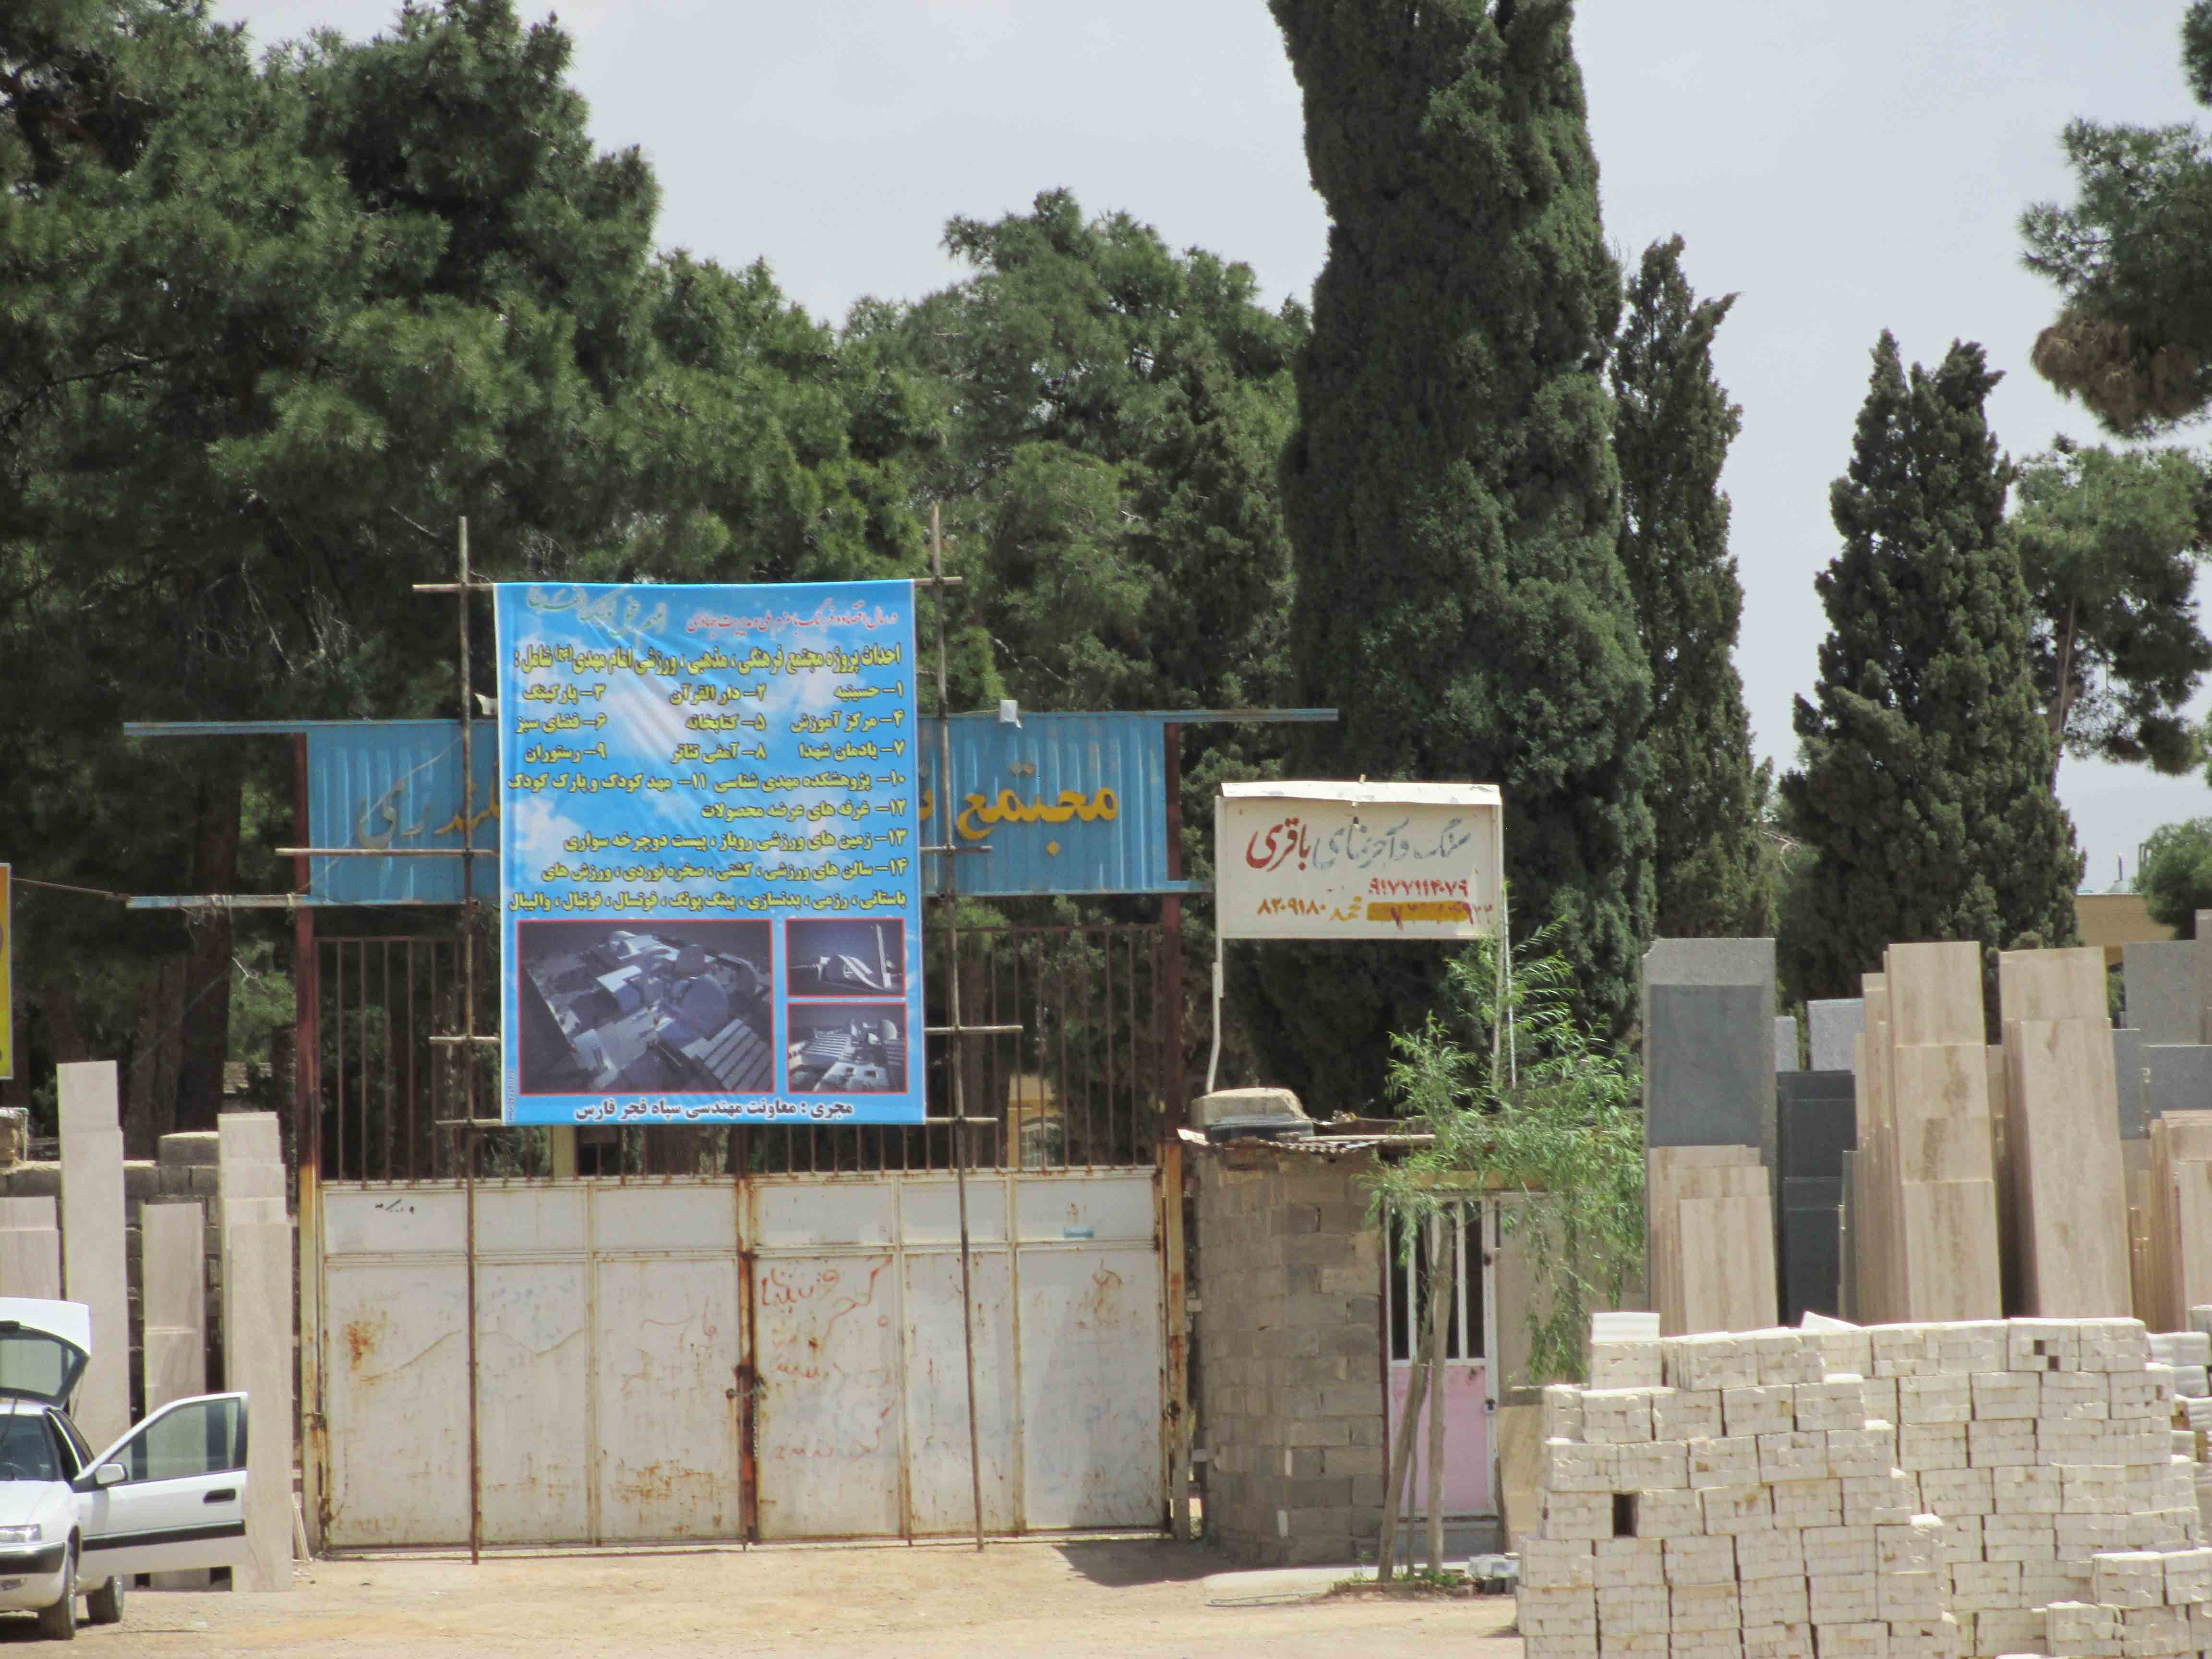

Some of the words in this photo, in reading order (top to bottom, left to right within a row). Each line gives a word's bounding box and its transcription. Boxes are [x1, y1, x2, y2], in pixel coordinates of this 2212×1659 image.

[522, 644, 553, 673] شامل
[608, 645, 633, 675] امام
[634, 646, 678, 676] ورزشی
[687, 646, 728, 674] مذهبی
[738, 645, 784, 674] فرهنگی
[785, 648, 824, 674] مجتمع
[827, 646, 860, 674] پروژه
[861, 642, 901, 666] احداث
[523, 683, 579, 705] پارکینگ
[834, 684, 880, 702] حسینیه
[515, 716, 541, 734] سبز
[542, 712, 580, 734] فضای
[685, 714, 740, 734] کتابخانه
[791, 710, 842, 733] آموزش
[844, 711, 878, 733] مرکز
[524, 742, 582, 764] رستوران
[702, 742, 740, 764] آمفی
[798, 741, 832, 761] شهدا
[833, 741, 879, 761] یادمان
[507, 772, 550, 793] کودک
[552, 772, 588, 793] پارک
[601, 772, 644, 793] کودک
[647, 775, 672, 792] مهد
[714, 771, 759, 793] شناسی
[761, 774, 801, 793] مهدی
[803, 771, 872, 792] پژوهشکده
[701, 802, 765, 823] محصولات
[767, 801, 805, 822] عرضه
[806, 800, 836, 821] های
[838, 799, 871, 821] غرفه
[956, 761, 1120, 857] مجتمع
[563, 831, 610, 853] سواری
[612, 831, 670, 853] دوچرخه
[671, 834, 709, 853] پیست
[718, 830, 754, 852] روباز
[756, 831, 806, 852] ورزشی
[807, 830, 836, 852] های
[839, 831, 873, 851] زمین
[1245, 816, 1311, 872] باقری
[1413, 817, 1472, 860] سنگ
[541, 862, 569, 882] های
[571, 862, 613, 882] ورزش
[623, 862, 666, 882] نوردی
[667, 862, 706, 882] صخره
[716, 861, 754, 881] کشتی
[764, 862, 810, 881] ورزشی
[812, 860, 840, 881] های
[841, 860, 874, 880] سالن
[509, 891, 553, 912] والیبال
[562, 891, 603, 911] فوتبال
[613, 891, 658, 911] فوتسال
[747, 891, 801, 911] بدنسازی
[812, 893, 849, 910] رزمی
[859, 890, 907, 910] باستانی
[576, 1098, 616, 1120] فارس
[618, 1098, 647, 1119] فجر
[651, 1098, 681, 1120] سپاه
[686, 1099, 743, 1119] مهندسی
[746, 1098, 797, 1119] معاونت
[810, 1101, 854, 1119] مجری
